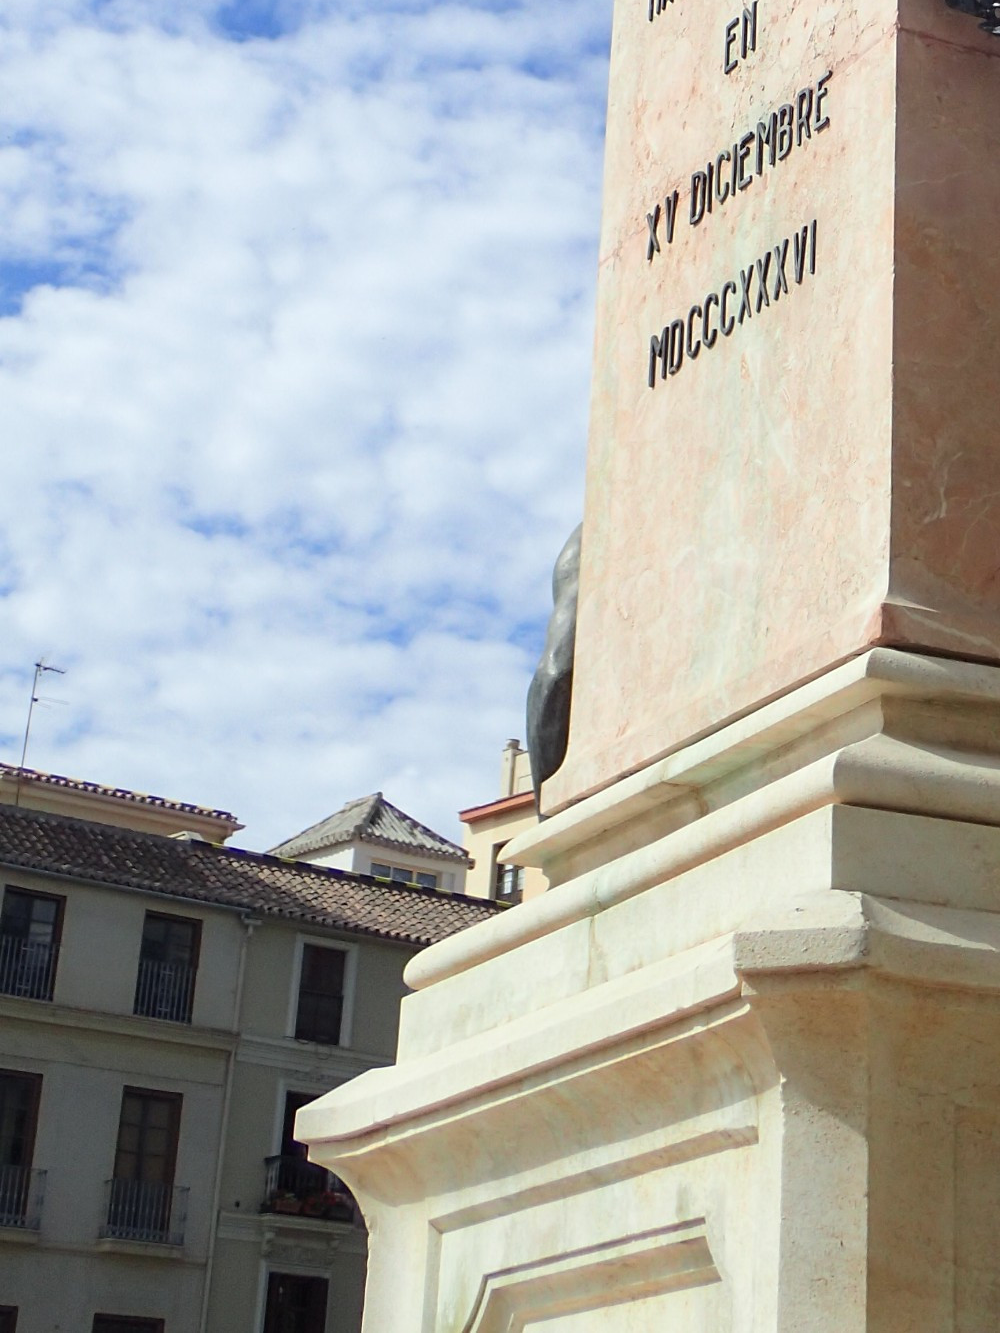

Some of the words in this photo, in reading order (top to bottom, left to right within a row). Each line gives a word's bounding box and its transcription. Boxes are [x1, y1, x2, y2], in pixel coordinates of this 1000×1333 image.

[724, 1, 757, 74] EN
[647, 189, 679, 261] XV
[689, 70, 832, 226] DICIEMBRE
[649, 219, 817, 389] MDCCCXXXVI
